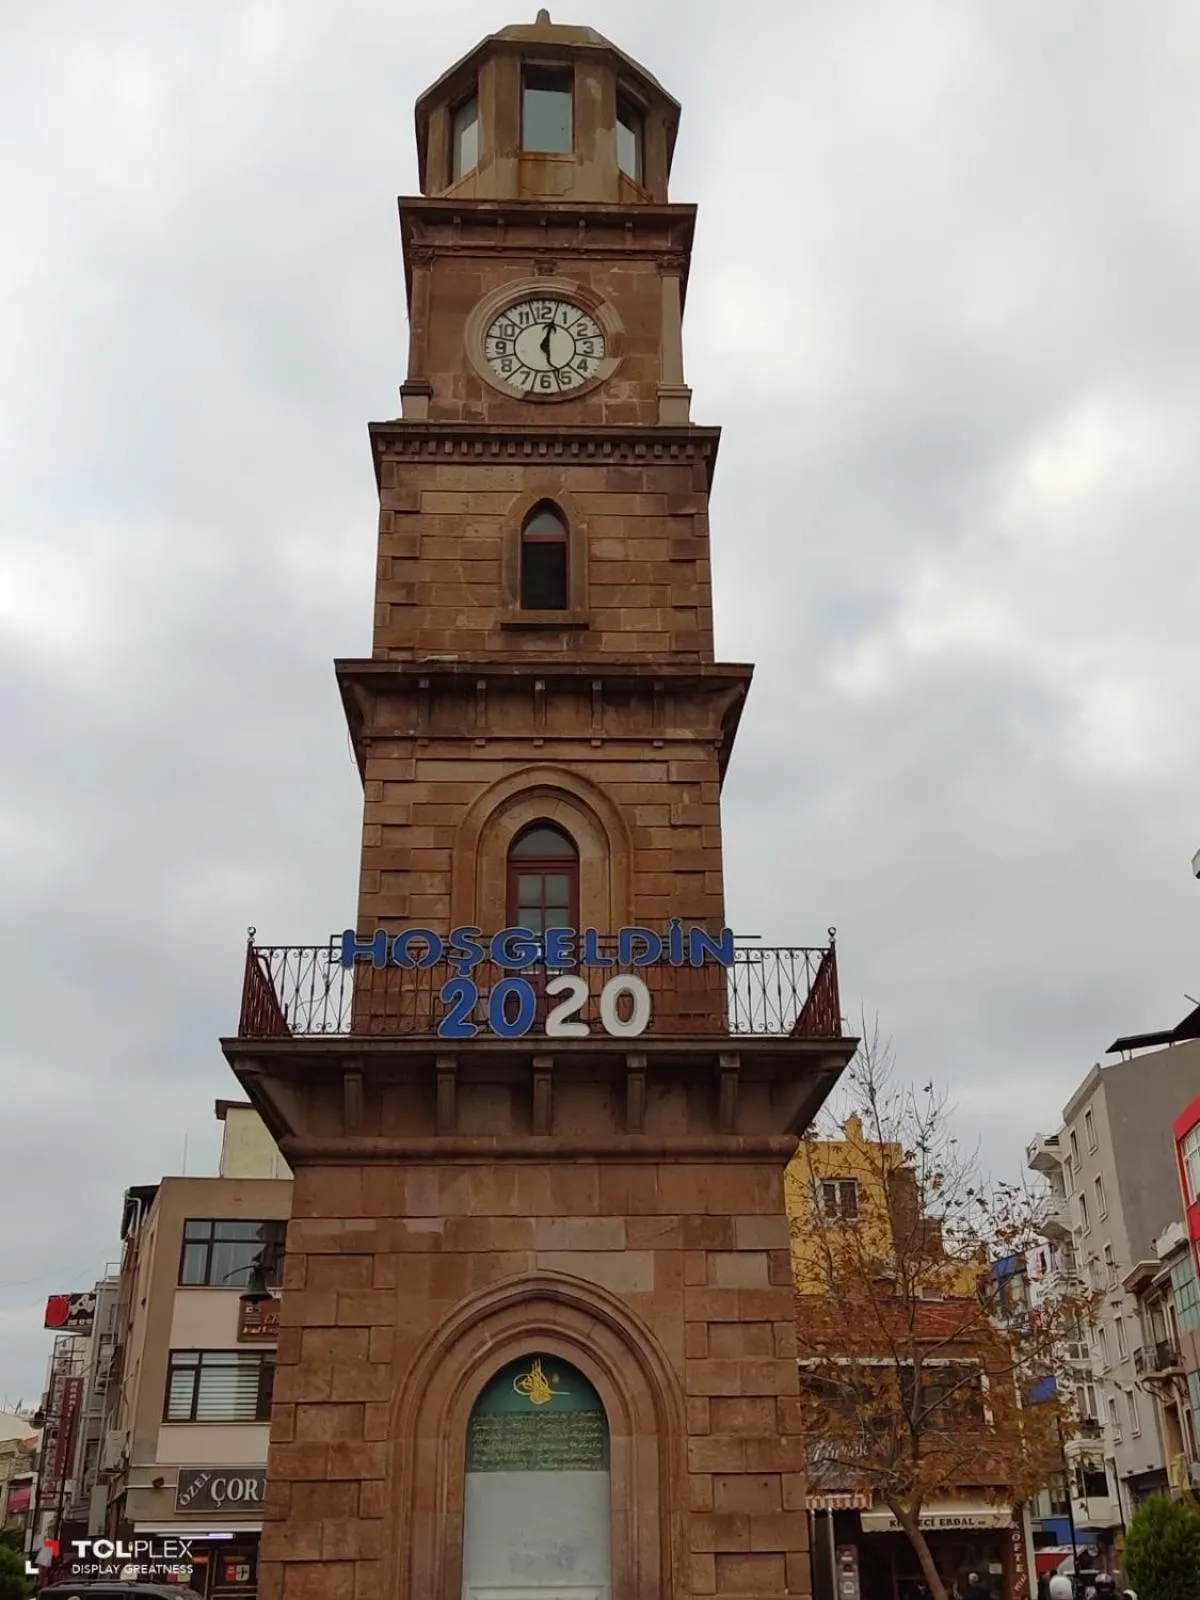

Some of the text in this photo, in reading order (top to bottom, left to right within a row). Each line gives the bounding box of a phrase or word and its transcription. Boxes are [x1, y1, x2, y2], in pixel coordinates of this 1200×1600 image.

[518, 311, 531, 324] 11
[536, 306, 553, 320] 12
[561, 311, 568, 324] 1
[499, 323, 516, 337] 10
[576, 323, 588, 336] 2
[495, 340, 507, 355] 9
[583, 341, 594, 354] 3
[501, 359, 513, 373] 8
[576, 359, 588, 372] 4
[519, 371, 531, 385] 7
[540, 375, 551, 389] 6
[560, 371, 572, 385] 5
[340, 916, 736, 977] HOŞGELDİN
[437, 974, 652, 1038] 2020
[939, 1517, 975, 1527] ERDAL
